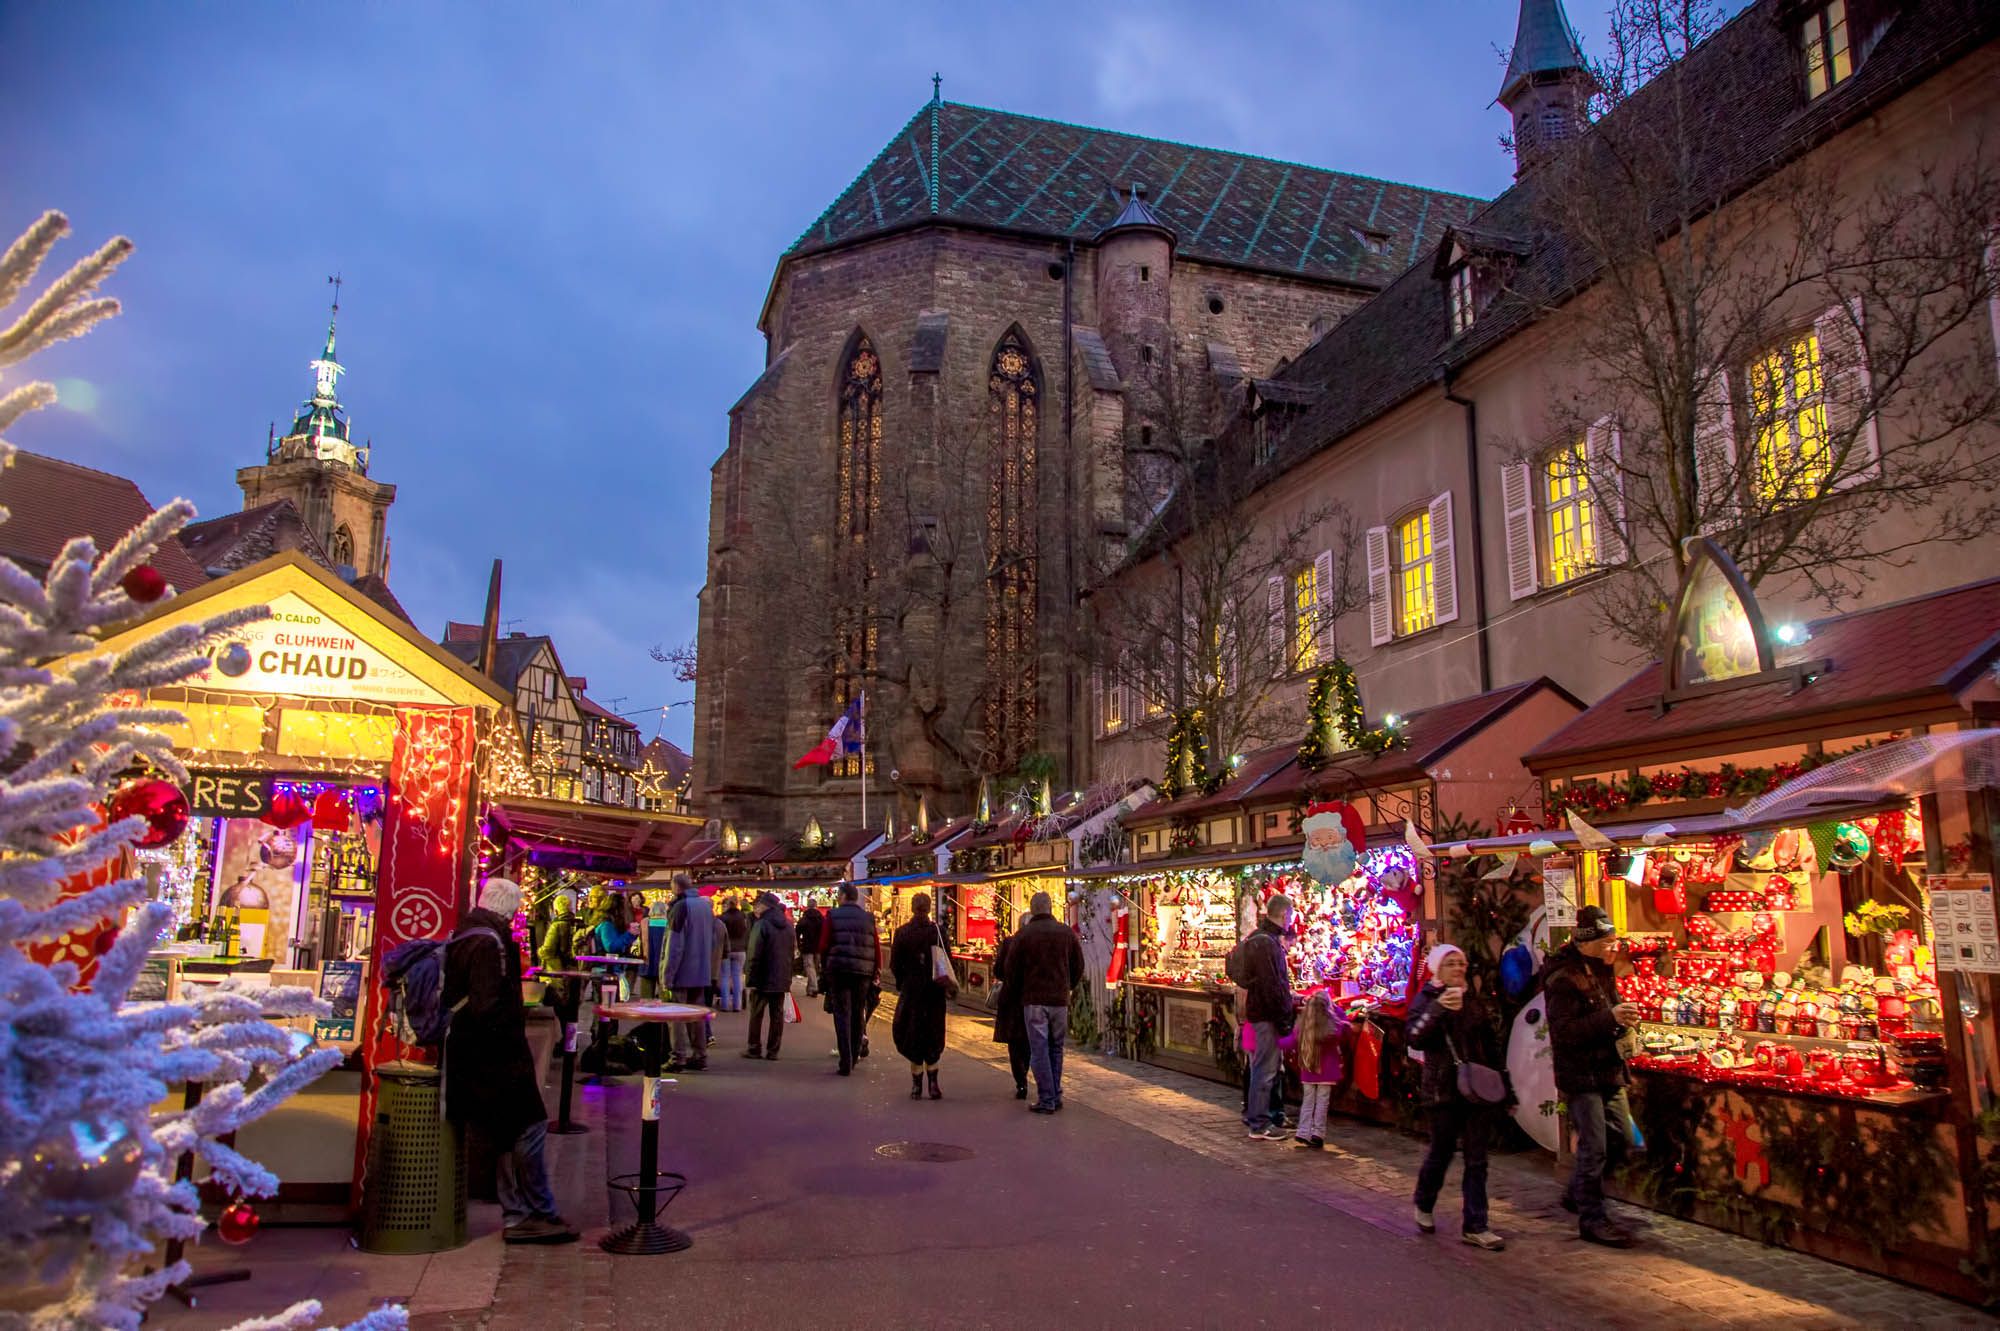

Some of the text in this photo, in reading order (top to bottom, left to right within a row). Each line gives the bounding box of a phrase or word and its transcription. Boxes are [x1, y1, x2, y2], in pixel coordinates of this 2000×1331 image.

[285, 613, 321, 625] CALDO
[274, 633, 355, 650] GLUHWEIN
[259, 650, 368, 680] CHAUD
[193, 775, 262, 812] RES
